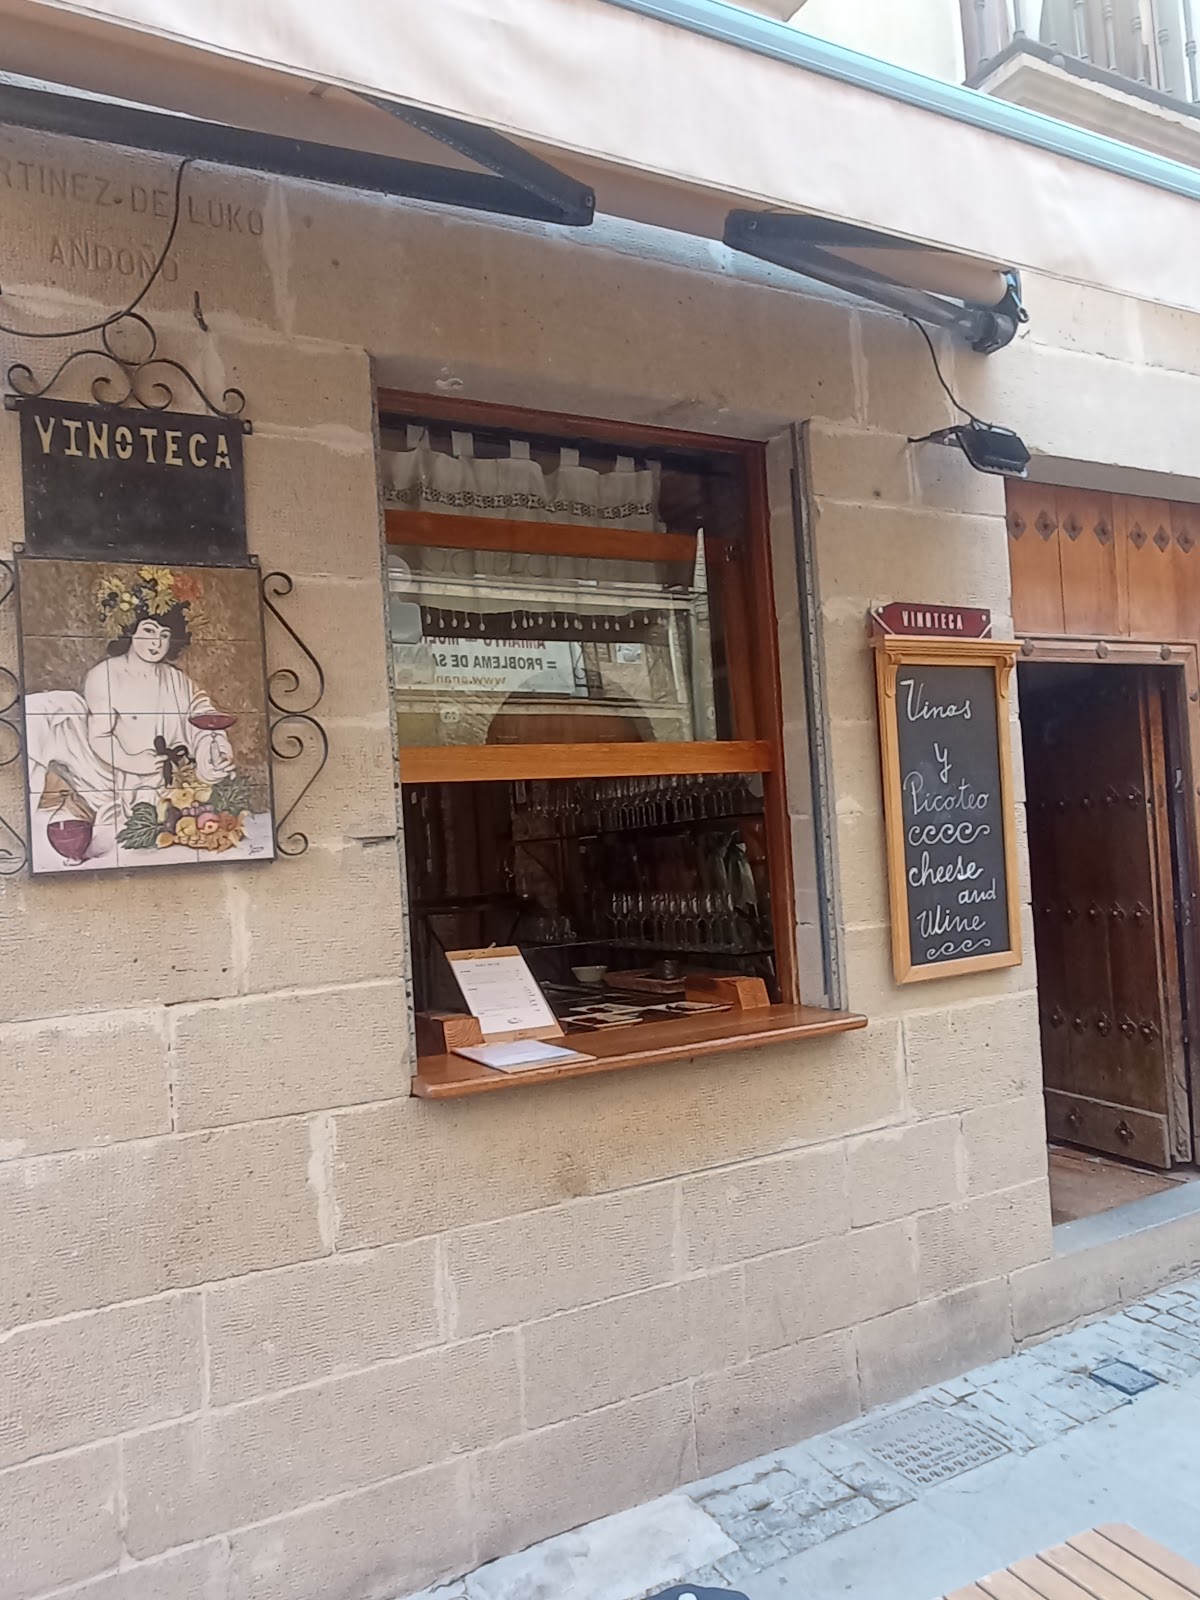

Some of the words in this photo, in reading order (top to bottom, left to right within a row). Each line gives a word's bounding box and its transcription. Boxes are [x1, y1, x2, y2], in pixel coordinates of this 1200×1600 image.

[34, 410, 232, 470] VINOTECA
[901, 609, 964, 631] VINOTECA
[899, 678, 972, 727] Vinos
[902, 771, 990, 816] Picoteo
[957, 877, 998, 905] and
[915, 904, 987, 938] Wine
